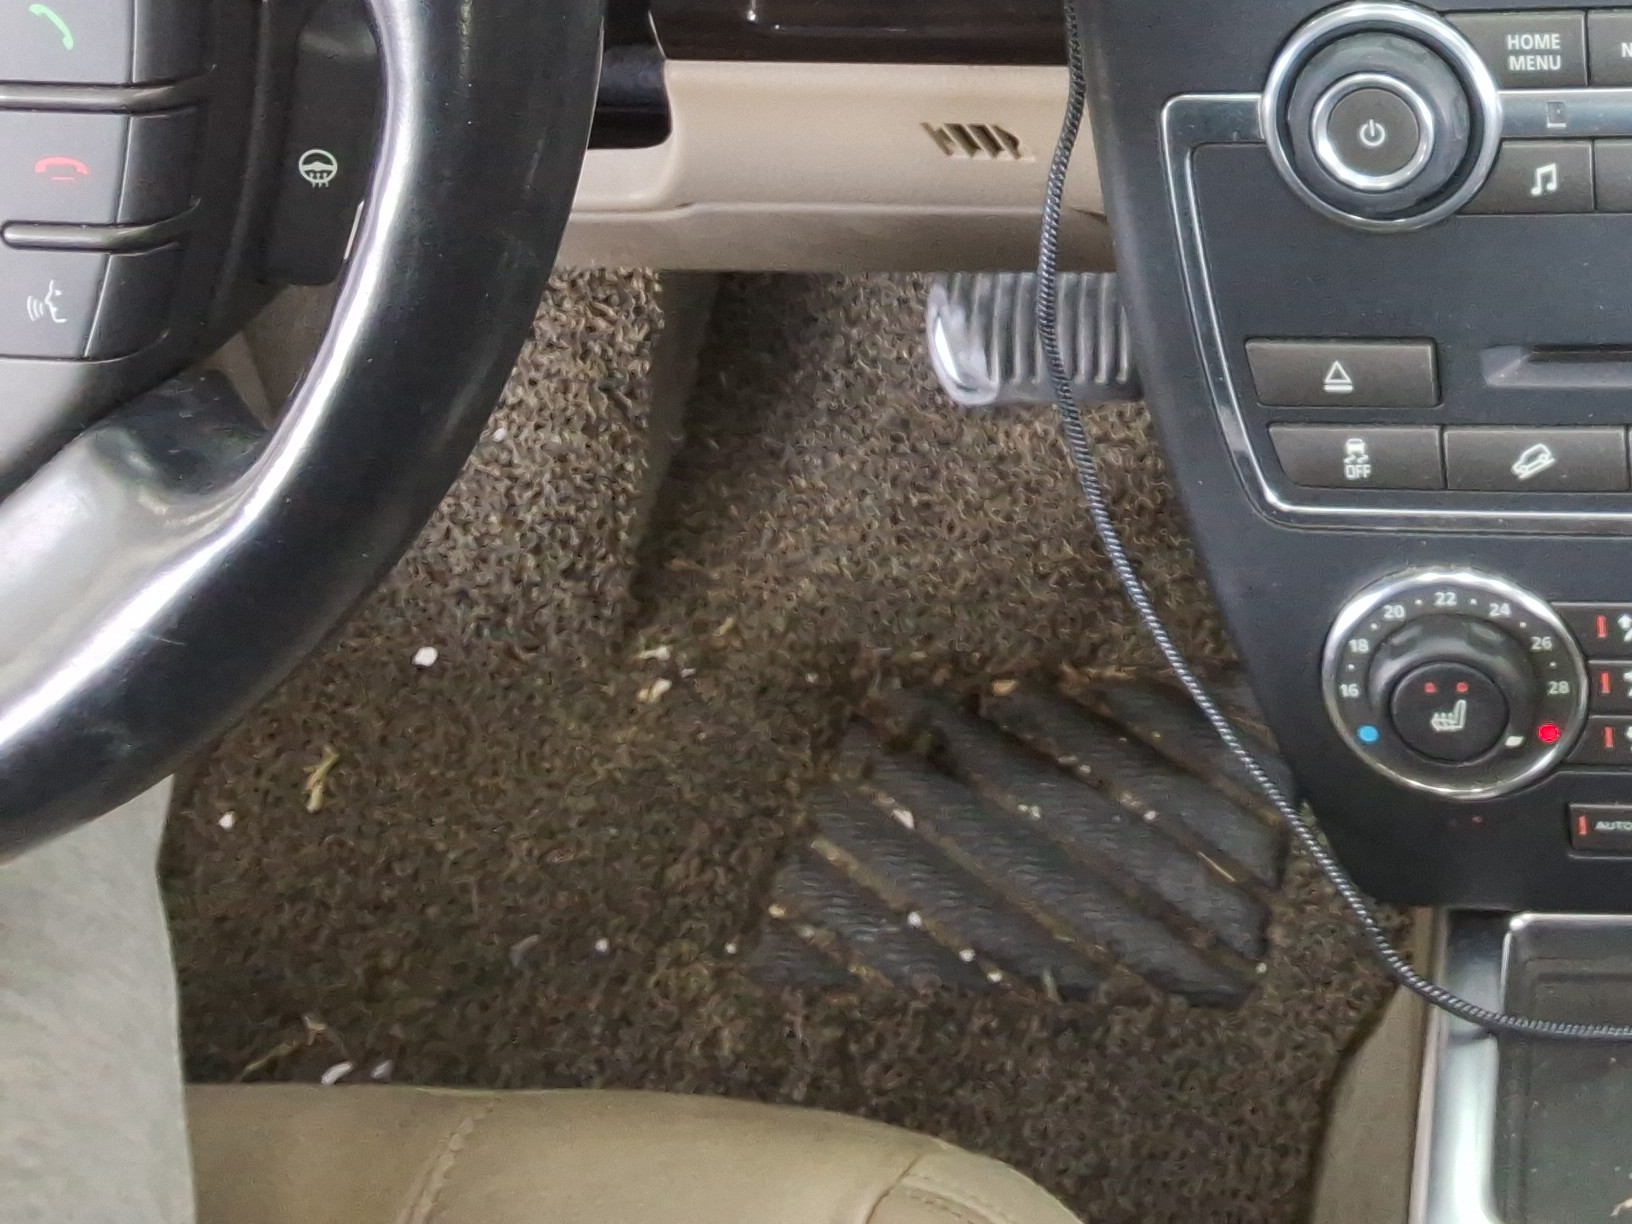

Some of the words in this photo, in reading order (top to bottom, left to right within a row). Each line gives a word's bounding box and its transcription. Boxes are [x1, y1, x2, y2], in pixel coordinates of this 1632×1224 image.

[1507, 33, 1561, 50] HOME
[1508, 54, 1561, 71] MENU
[1345, 464, 1371, 480] OFF
[1434, 591, 1458, 607] 22
[1383, 604, 1406, 620] 20
[1489, 601, 1512, 618] 24
[1349, 637, 1370, 654] 18
[1531, 636, 1553, 652] 26
[1340, 682, 1360, 698] 16
[1547, 680, 1571, 695] 28
